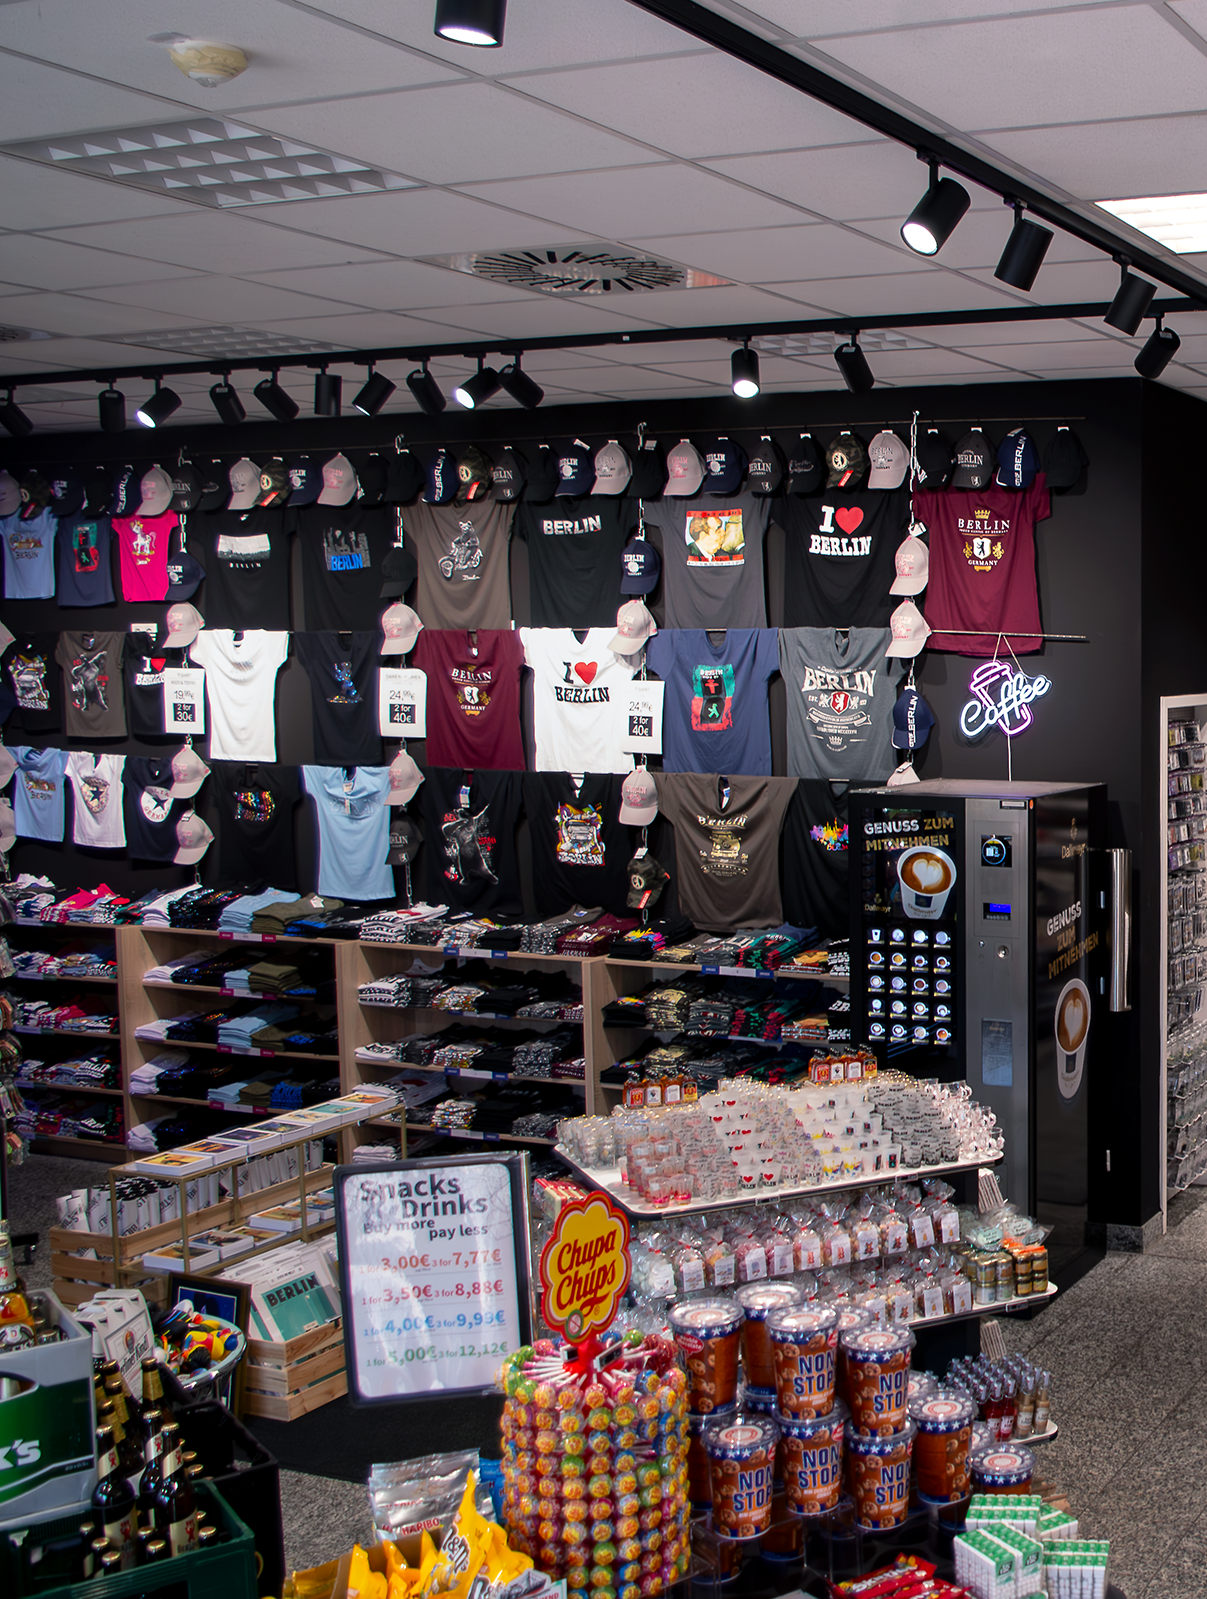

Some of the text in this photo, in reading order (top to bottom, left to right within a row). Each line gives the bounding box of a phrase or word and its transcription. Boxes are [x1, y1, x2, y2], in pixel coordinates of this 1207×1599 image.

[543, 515, 601, 535] BERLIN
[819, 505, 835, 533] I
[958, 518, 1010, 530] BERLIN
[809, 534, 872, 556] BERLIN
[331, 553, 363, 571] BERLIN
[451, 668, 492, 680] BERLIN
[562, 661, 573, 684] I
[801, 666, 877, 697] BERLIN
[554, 686, 611, 703] BERLIN
[960, 672, 1053, 736] Coffee
[177, 711, 193, 721] 30€
[183, 703, 192, 711] for
[394, 712, 412, 723] 40€
[401, 704, 411, 712] for
[632, 725, 649, 736] 40€
[633, 716, 649, 724] 2 for
[864, 817, 954, 835] GENUSS ZUM
[865, 835, 949, 851] MITNEHMEN
[1046, 901, 1082, 936] GENUSS
[1056, 925, 1076, 951] ZUM
[1048, 931, 1099, 979] MITNEHMEN
[360, 1174, 461, 1201] Snacks
[401, 1194, 488, 1219] Drinks
[364, 1219, 435, 1235] Buy more
[429, 1224, 488, 1241] pay less
[381, 1254, 430, 1271] 3,00€
[438, 1258, 452, 1267] for
[453, 1249, 501, 1268] 7,77€
[557, 1229, 618, 1274] Chupa
[266, 1274, 320, 1307] BERLIN
[383, 1285, 433, 1304] 3,50€
[441, 1288, 454, 1298] for
[455, 1279, 504, 1298] 8,88€
[556, 1260, 616, 1311] Chups
[385, 1315, 435, 1335] 4,00€
[456, 1310, 506, 1329] 9,99€
[373, 1357, 385, 1367] for
[388, 1346, 437, 1365] 5,00€
[445, 1350, 458, 1359] for
[459, 1341, 508, 1357] 12,12€
[798, 1351, 835, 1374] NON
[802, 1445, 840, 1469] NON
[402, 1518, 440, 1536] HARIBO
